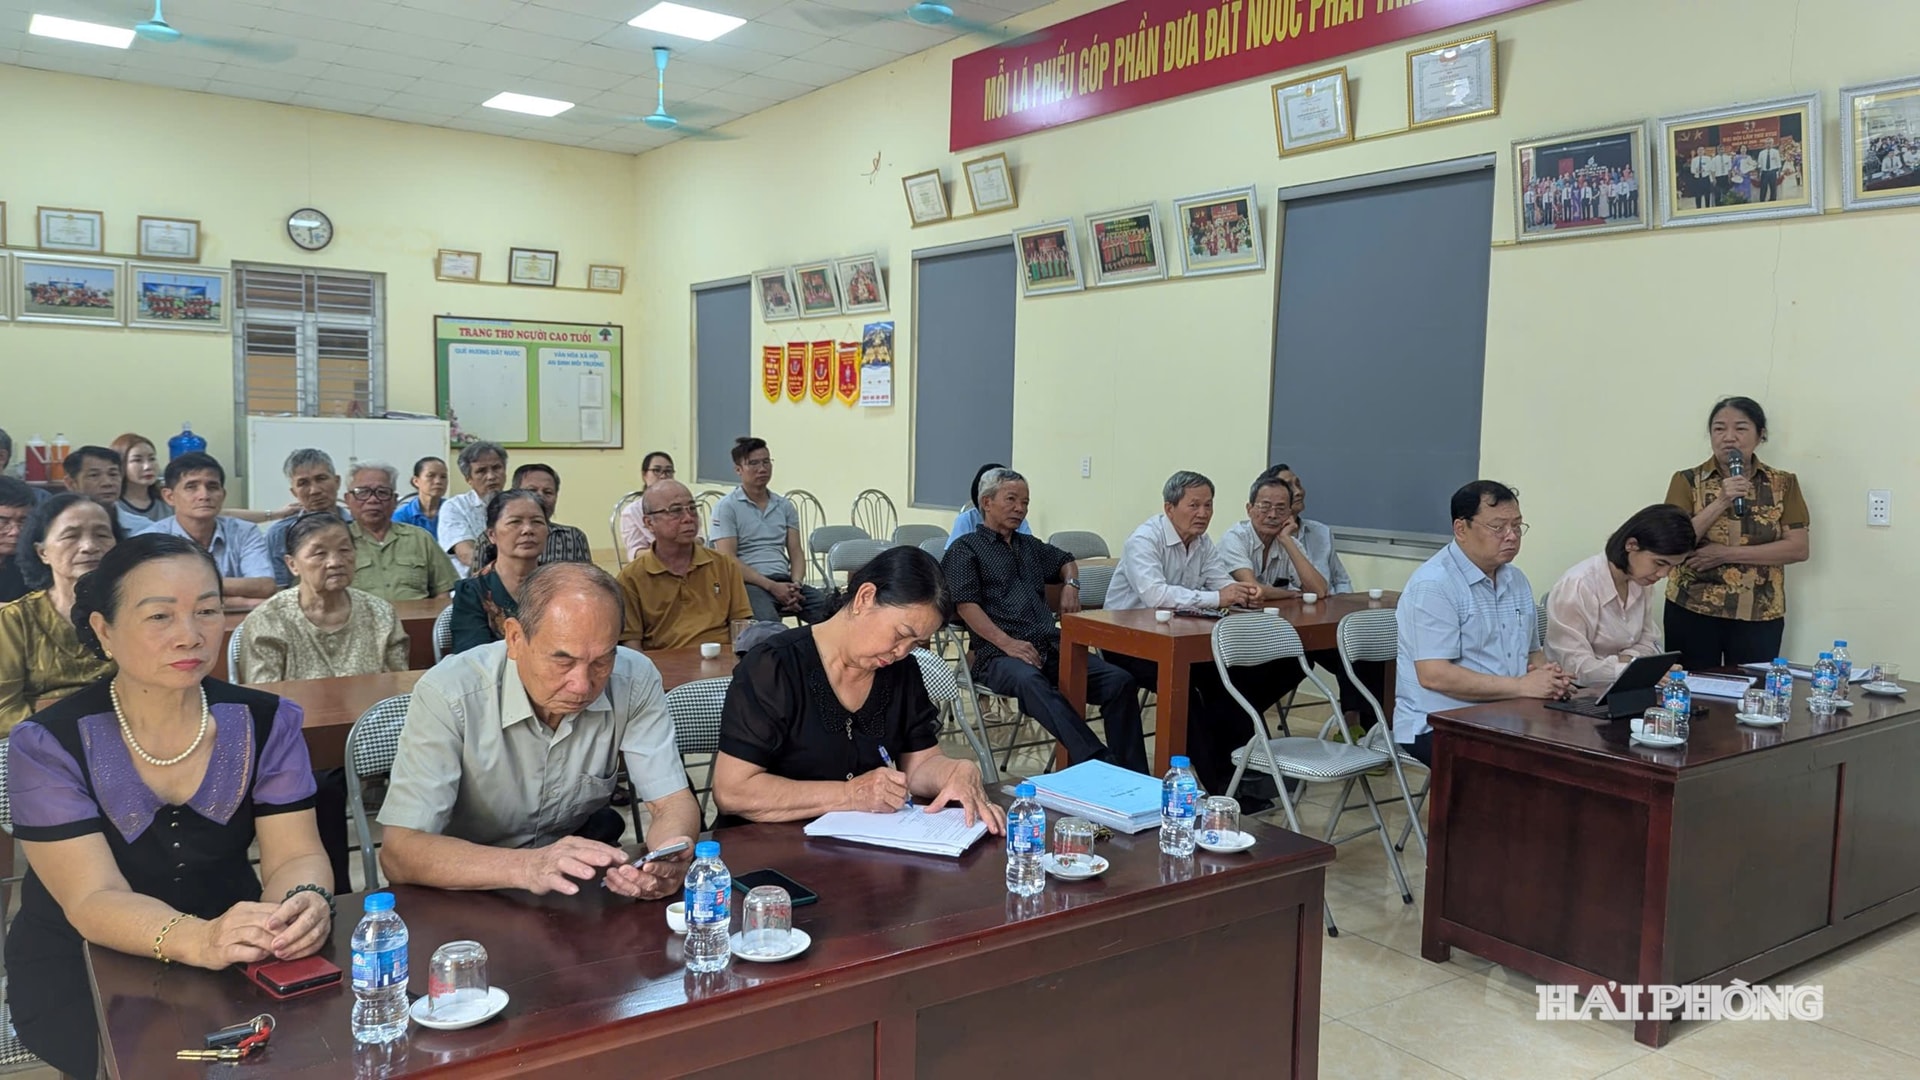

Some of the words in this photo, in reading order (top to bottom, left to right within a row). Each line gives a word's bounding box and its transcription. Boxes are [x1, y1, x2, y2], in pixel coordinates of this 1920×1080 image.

[984, 56, 1009, 121] MỖI
[1012, 56, 1028, 113] LÁ
[1032, 39, 1075, 107] PHIẾU
[1078, 34, 1110, 96] GÓP
[1113, 12, 1160, 86] PHẦN
[1163, 10, 1199, 72] ĐƯA
[459, 327, 492, 338] TRANG
[516, 329, 547, 341] NGƯỜI
[549, 331, 568, 342] CAO
[570, 329, 591, 343] TUỐI
